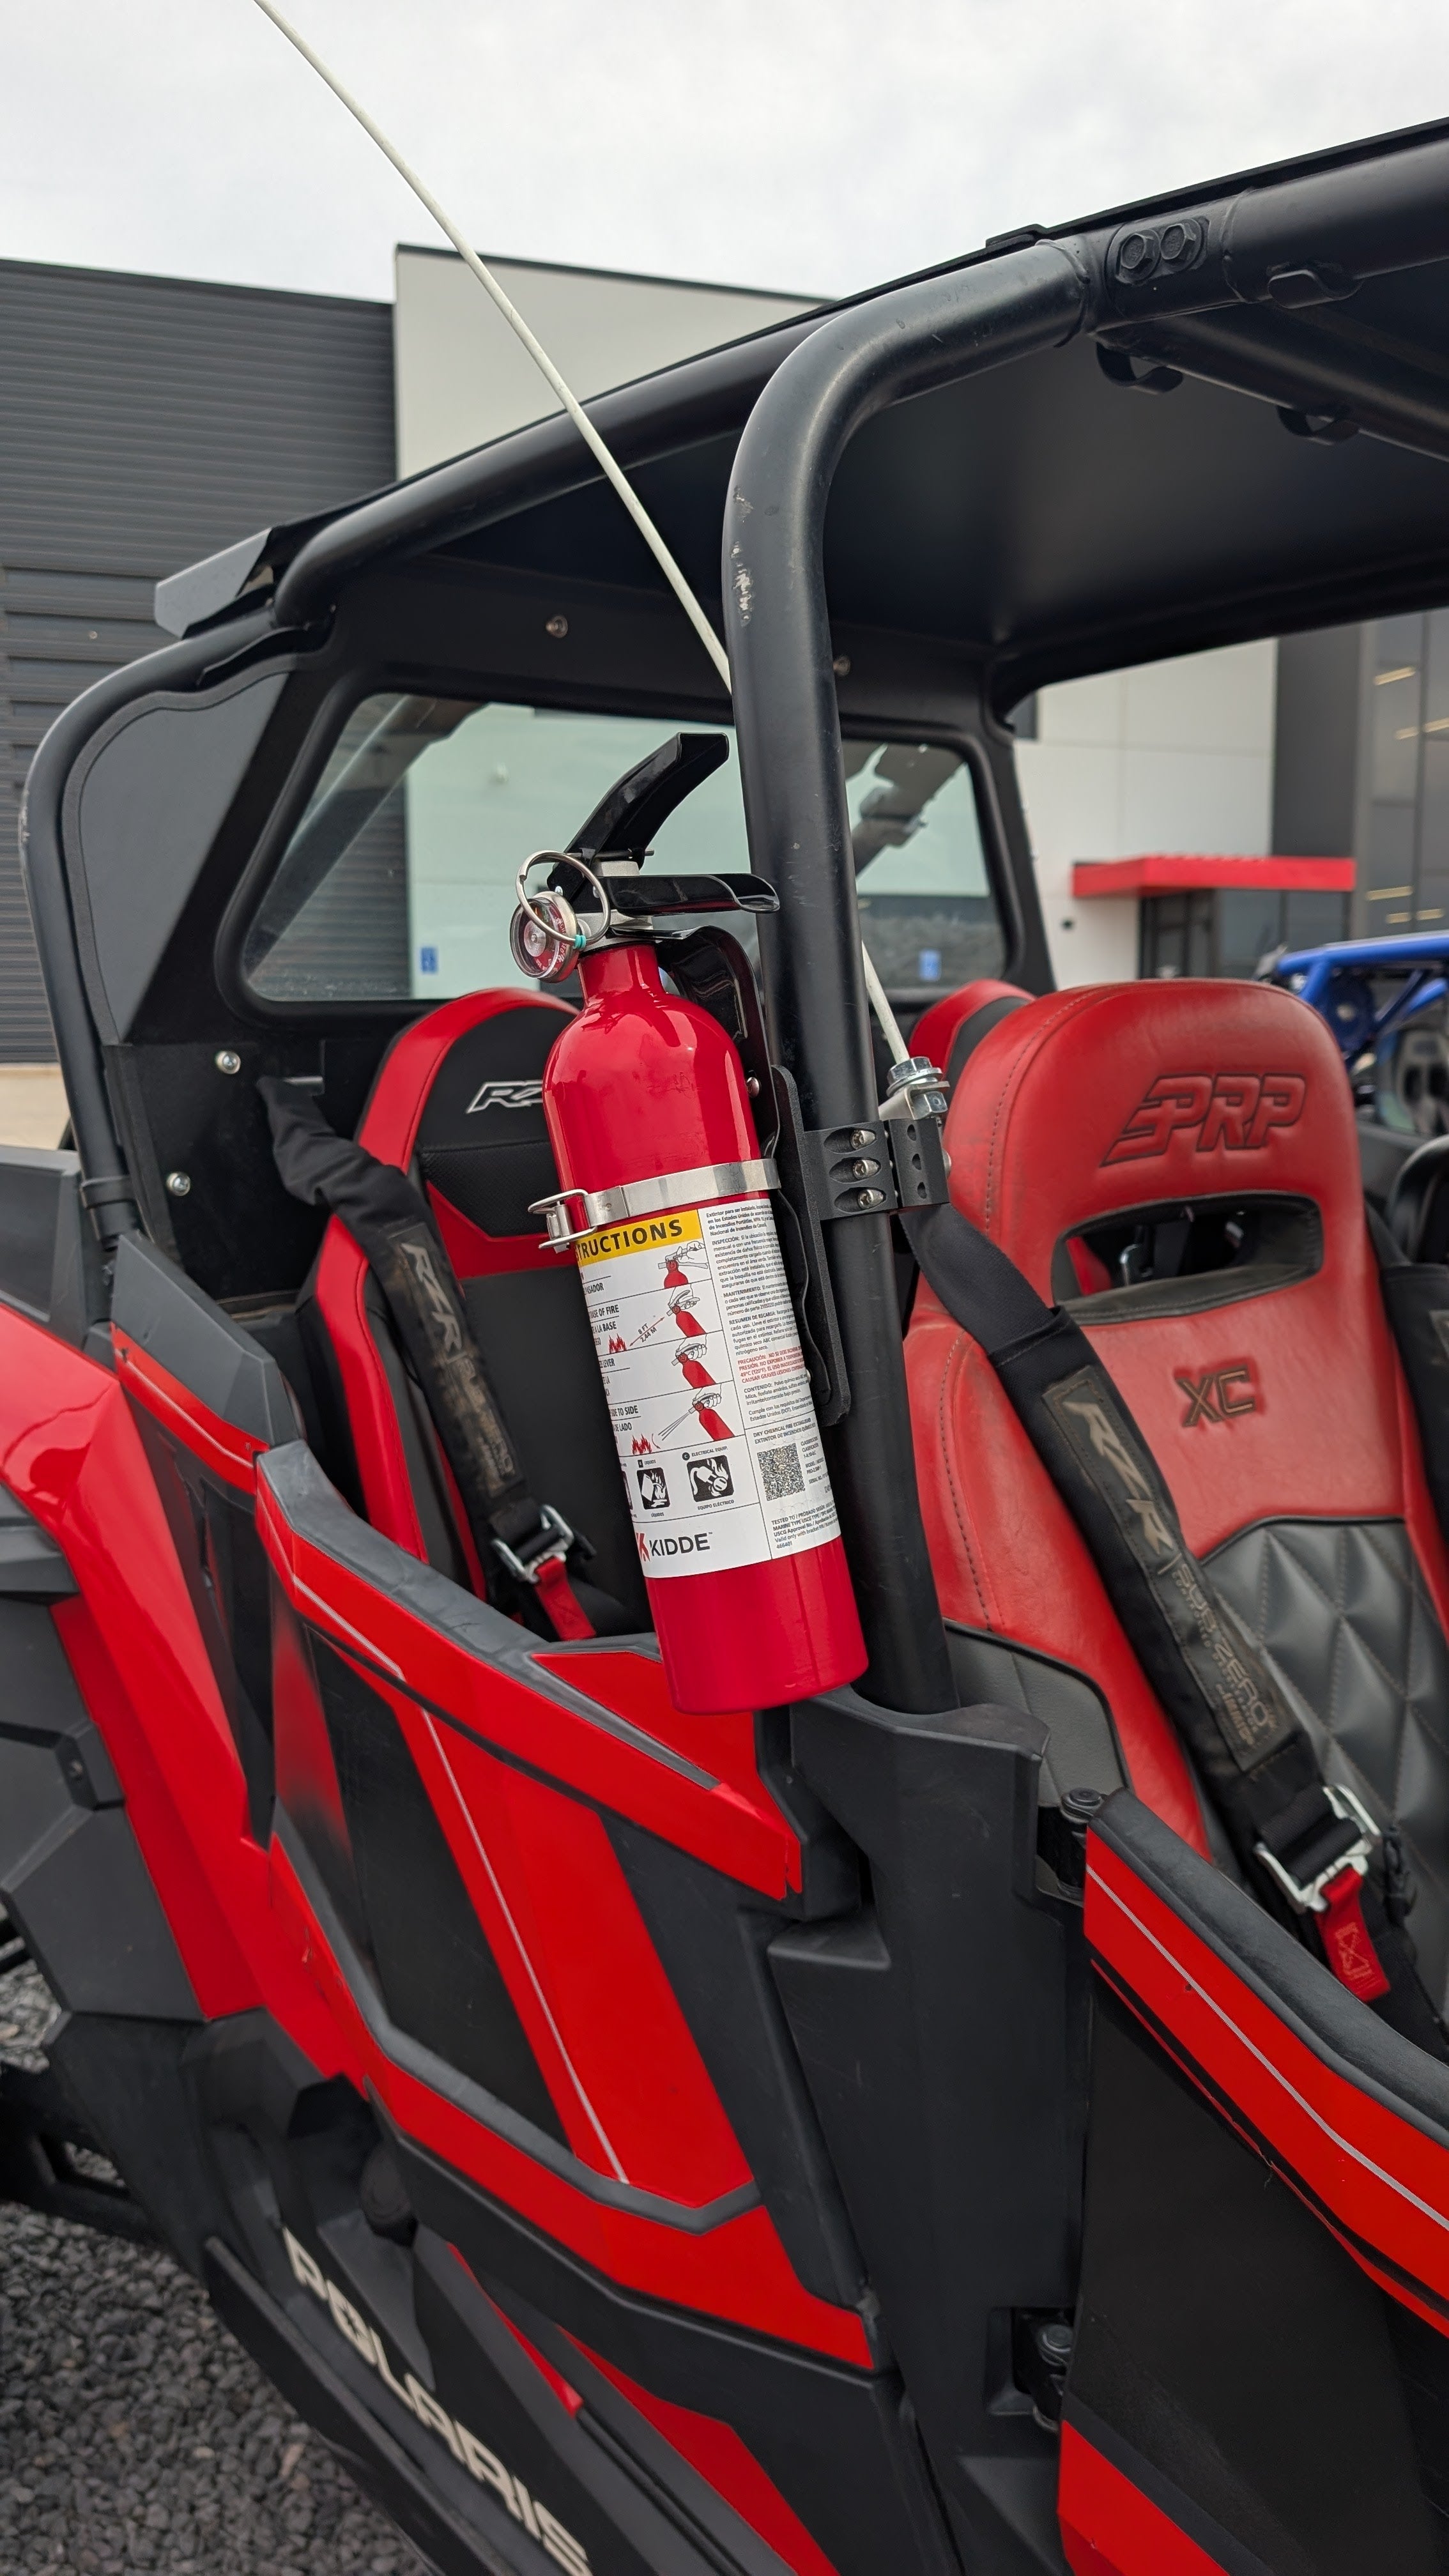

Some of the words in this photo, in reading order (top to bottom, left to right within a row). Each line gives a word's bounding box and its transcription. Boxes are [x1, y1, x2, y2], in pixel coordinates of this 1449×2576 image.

[466, 1080, 543, 1114] RZ
[1099, 1072, 1306, 1168] PRP
[712, 1236, 739, 1245] INSPECCIÓN:
[716, 1254, 748, 1264] completamente
[599, 1308, 605, 1317] OF
[606, 1305, 619, 1315] FIRE
[602, 1321, 617, 1331] BASE
[732, 1329, 755, 1337] autorizada
[738, 1355, 766, 1365] PRECAUCIÓN:
[744, 1383, 772, 1393] CONTENIDO:
[1175, 1363, 1257, 1428] XC
[625, 1405, 638, 1415] SIDE
[619, 1422, 632, 1431] LADO
[764, 1426, 785, 1434] CHEMICAL
[755, 1435, 776, 1444] EXTINTOR
[691, 1449, 714, 1457] ELECTRICAL
[1066, 1401, 1174, 1556] RZR
[713, 1499, 735, 1508] ELÉCTRICO
[798, 1508, 815, 1517] PROBADO
[773, 1522, 790, 1531] MARINE
[788, 1524, 806, 1533] Approval
[283, 2226, 593, 2576] POLARIS
